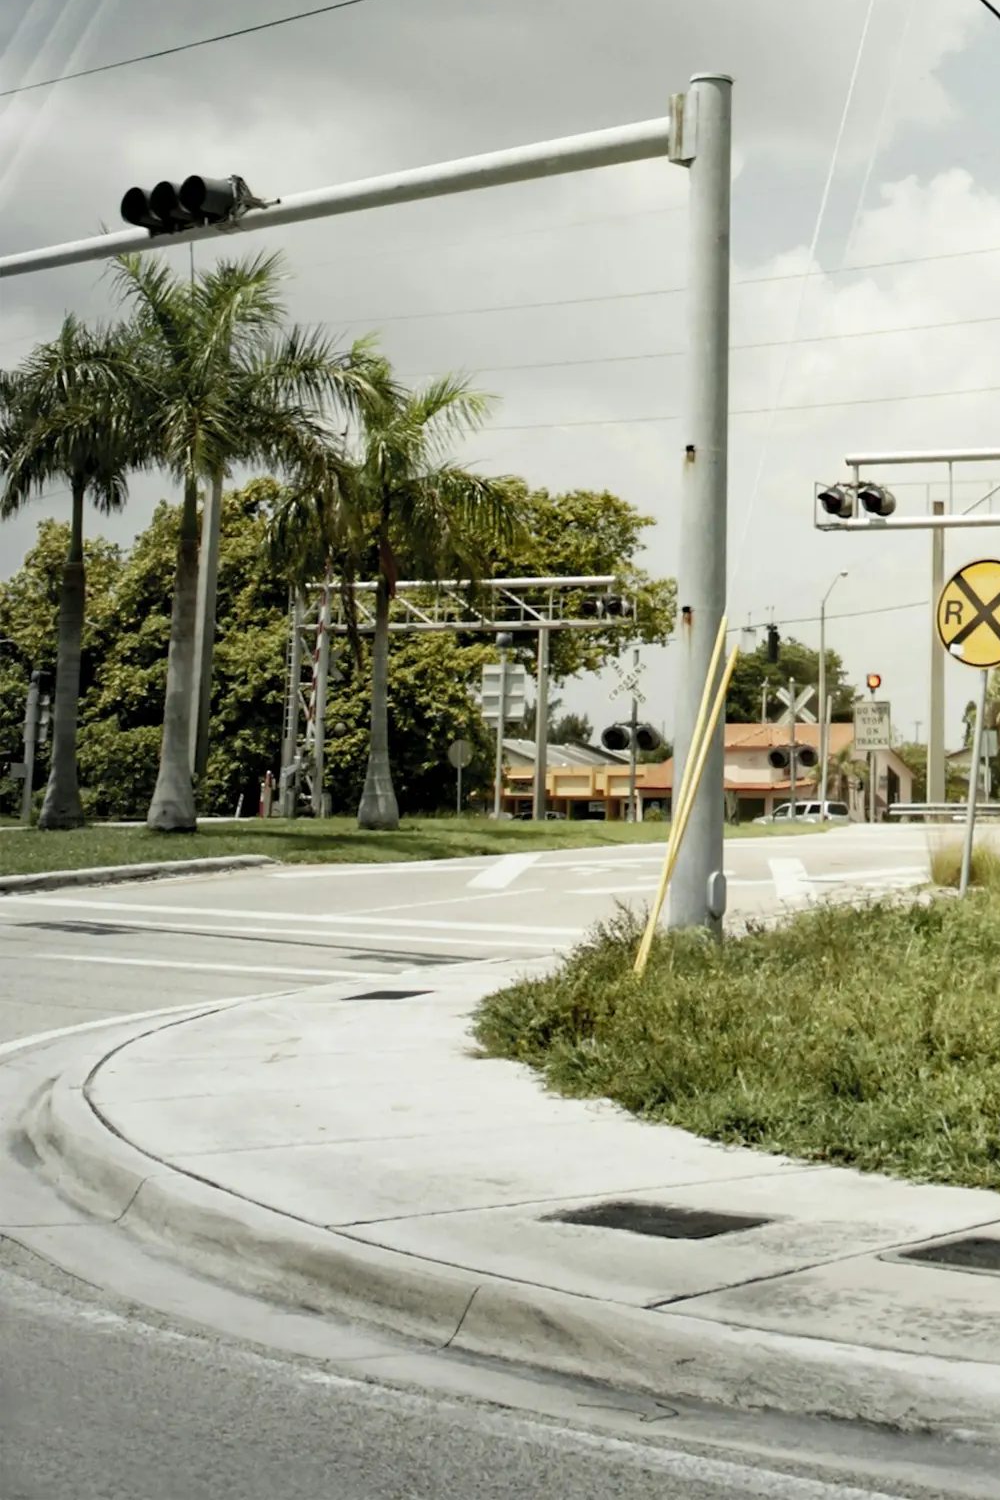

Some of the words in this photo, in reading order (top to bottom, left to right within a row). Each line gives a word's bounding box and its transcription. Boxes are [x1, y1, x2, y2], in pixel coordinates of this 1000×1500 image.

[944, 600, 964, 625] R
[608, 663, 647, 701] CROSSING
[857, 707, 868, 715] DO
[862, 716, 884, 725] STOP
[866, 727, 879, 736] ON
[856, 737, 889, 745] TRACKS
